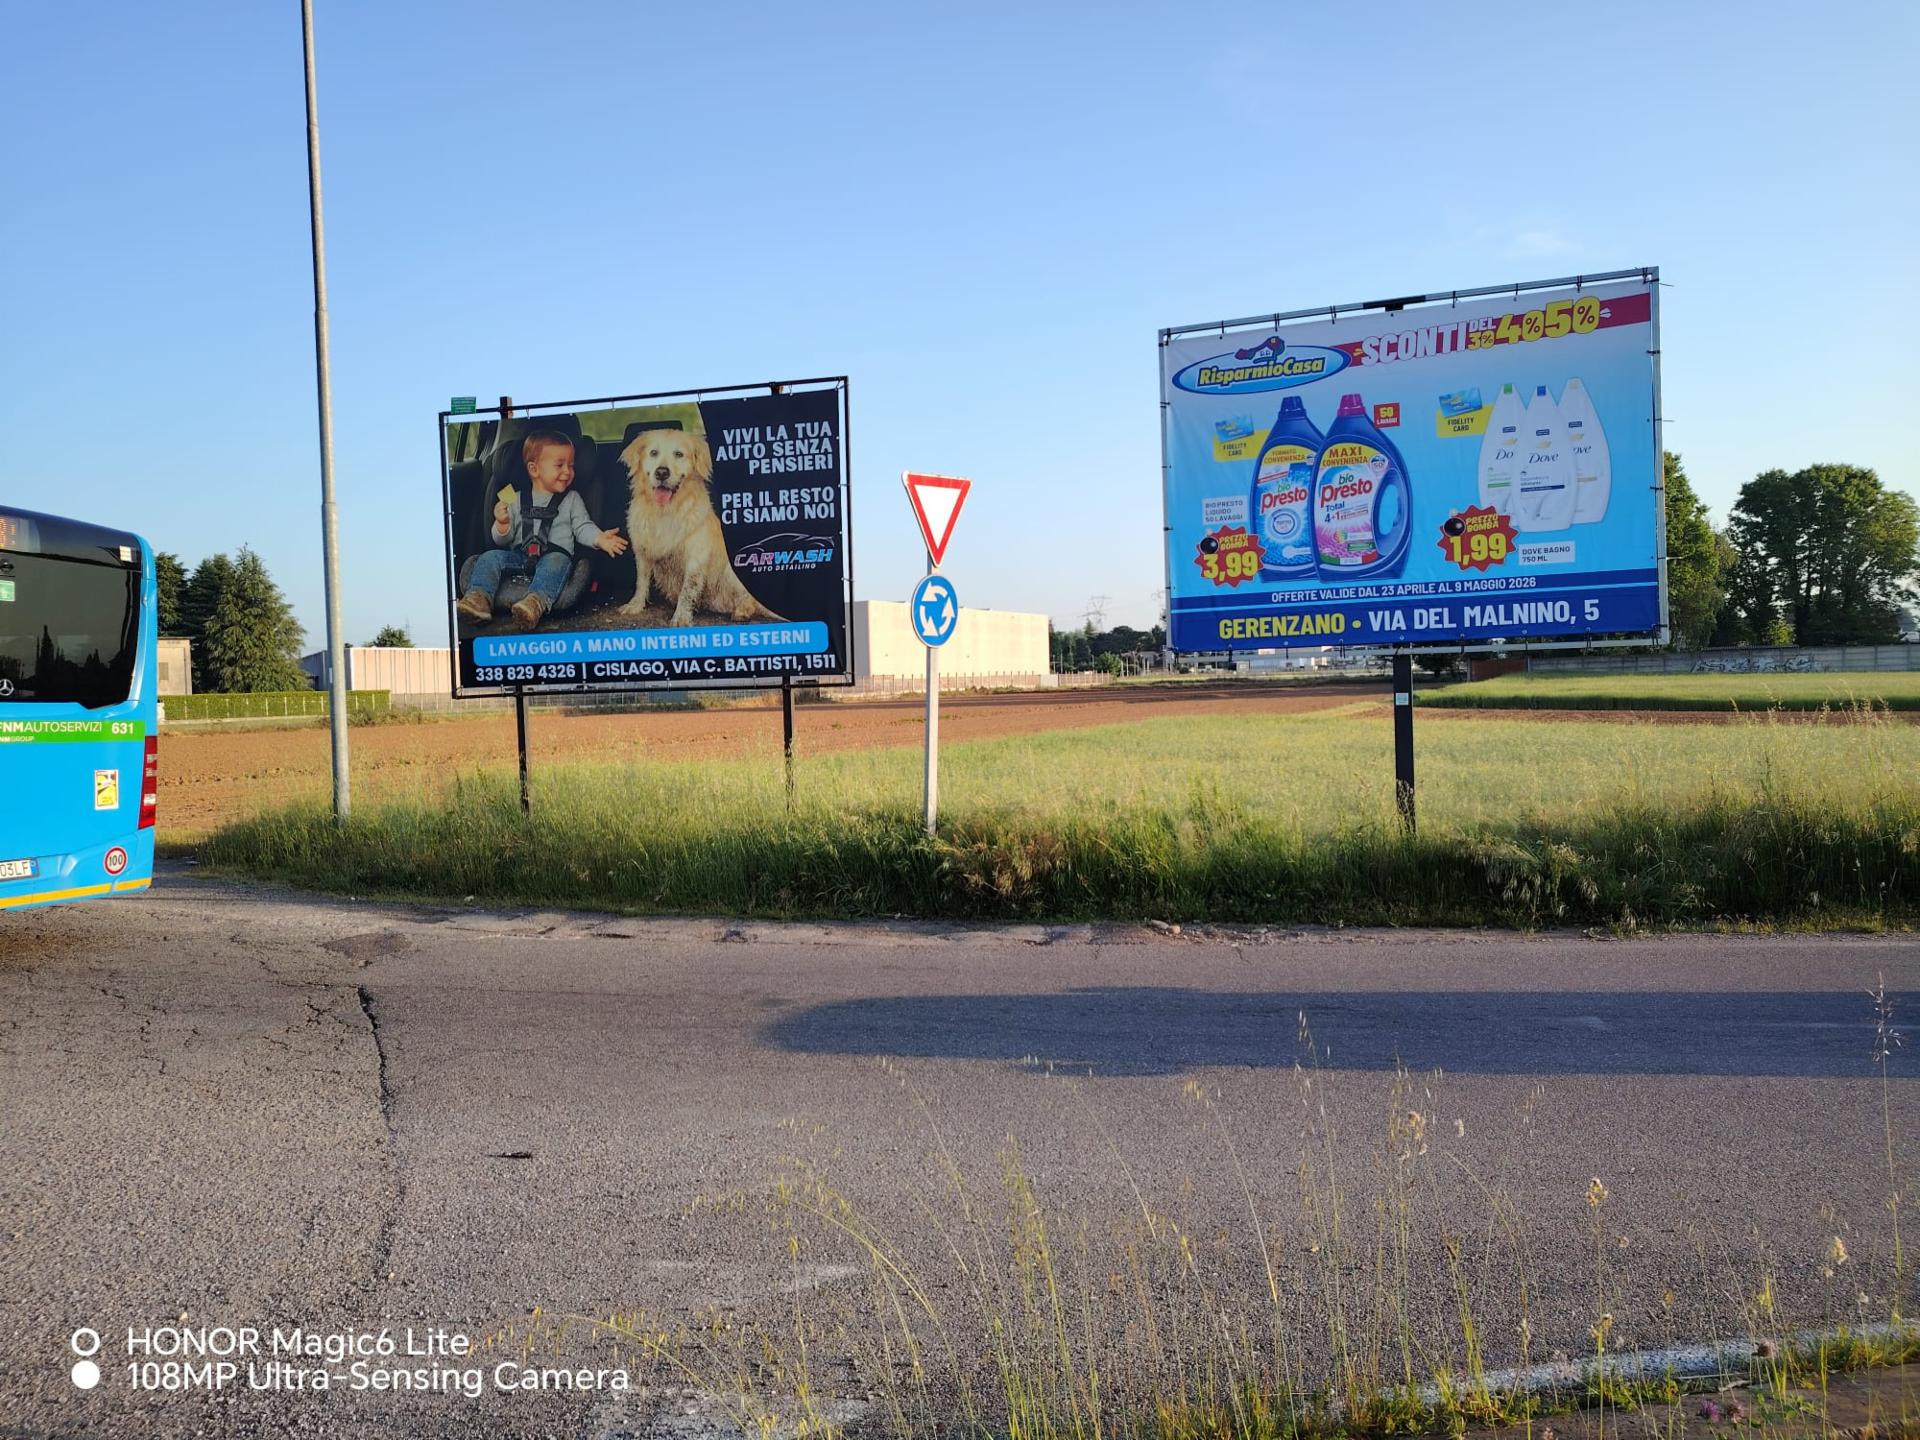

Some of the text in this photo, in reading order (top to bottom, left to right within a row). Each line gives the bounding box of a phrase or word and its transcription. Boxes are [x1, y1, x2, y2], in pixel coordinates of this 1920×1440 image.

[1361, 316, 1496, 367] SCONTI DEL
[1198, 357, 1326, 386] RisparmioCasa
[1380, 406, 1394, 418] 50
[1447, 416, 1474, 425] FIDELITY
[722, 421, 832, 444] VIVI LA TUA
[1452, 424, 1470, 432] CARD
[715, 438, 833, 461] AUTO SENZA
[1223, 442, 1247, 450] FIDELITY
[1329, 446, 1363, 458] MAXI
[749, 454, 833, 475] PENSIERI
[1322, 456, 1369, 467] CONVENIENZA
[1528, 453, 1559, 464] Dove
[1338, 473, 1354, 485] bio
[1277, 482, 1291, 493] bio
[721, 486, 835, 509] PER IL RESTO
[721, 502, 835, 525] CI SIAMO NOI
[1466, 513, 1499, 526] PREZZO
[1467, 521, 1499, 533] BOMBA
[1450, 532, 1507, 565] 1,99
[1522, 546, 1571, 555] DOVE BAGNO
[734, 548, 833, 567] CARWASH
[752, 563, 817, 573] AUTO DETAILING
[1203, 550, 1258, 582] 3,99
[1271, 576, 1537, 603] OFFERTE VALIDE DAL 23 APRILE AL 9 MAGGIO 2026
[1219, 599, 1600, 639] GERENZANO VIA DEL MALNINO, 5
[489, 629, 810, 657] LAVAGGIO A MANO INTERNI ED ESTERNI
[475, 654, 836, 682] 338 829 4326 CISLAGO, VIA C. BATTISTI, 1511
[111, 722, 134, 734] 631
[108, 854, 123, 867] 100
